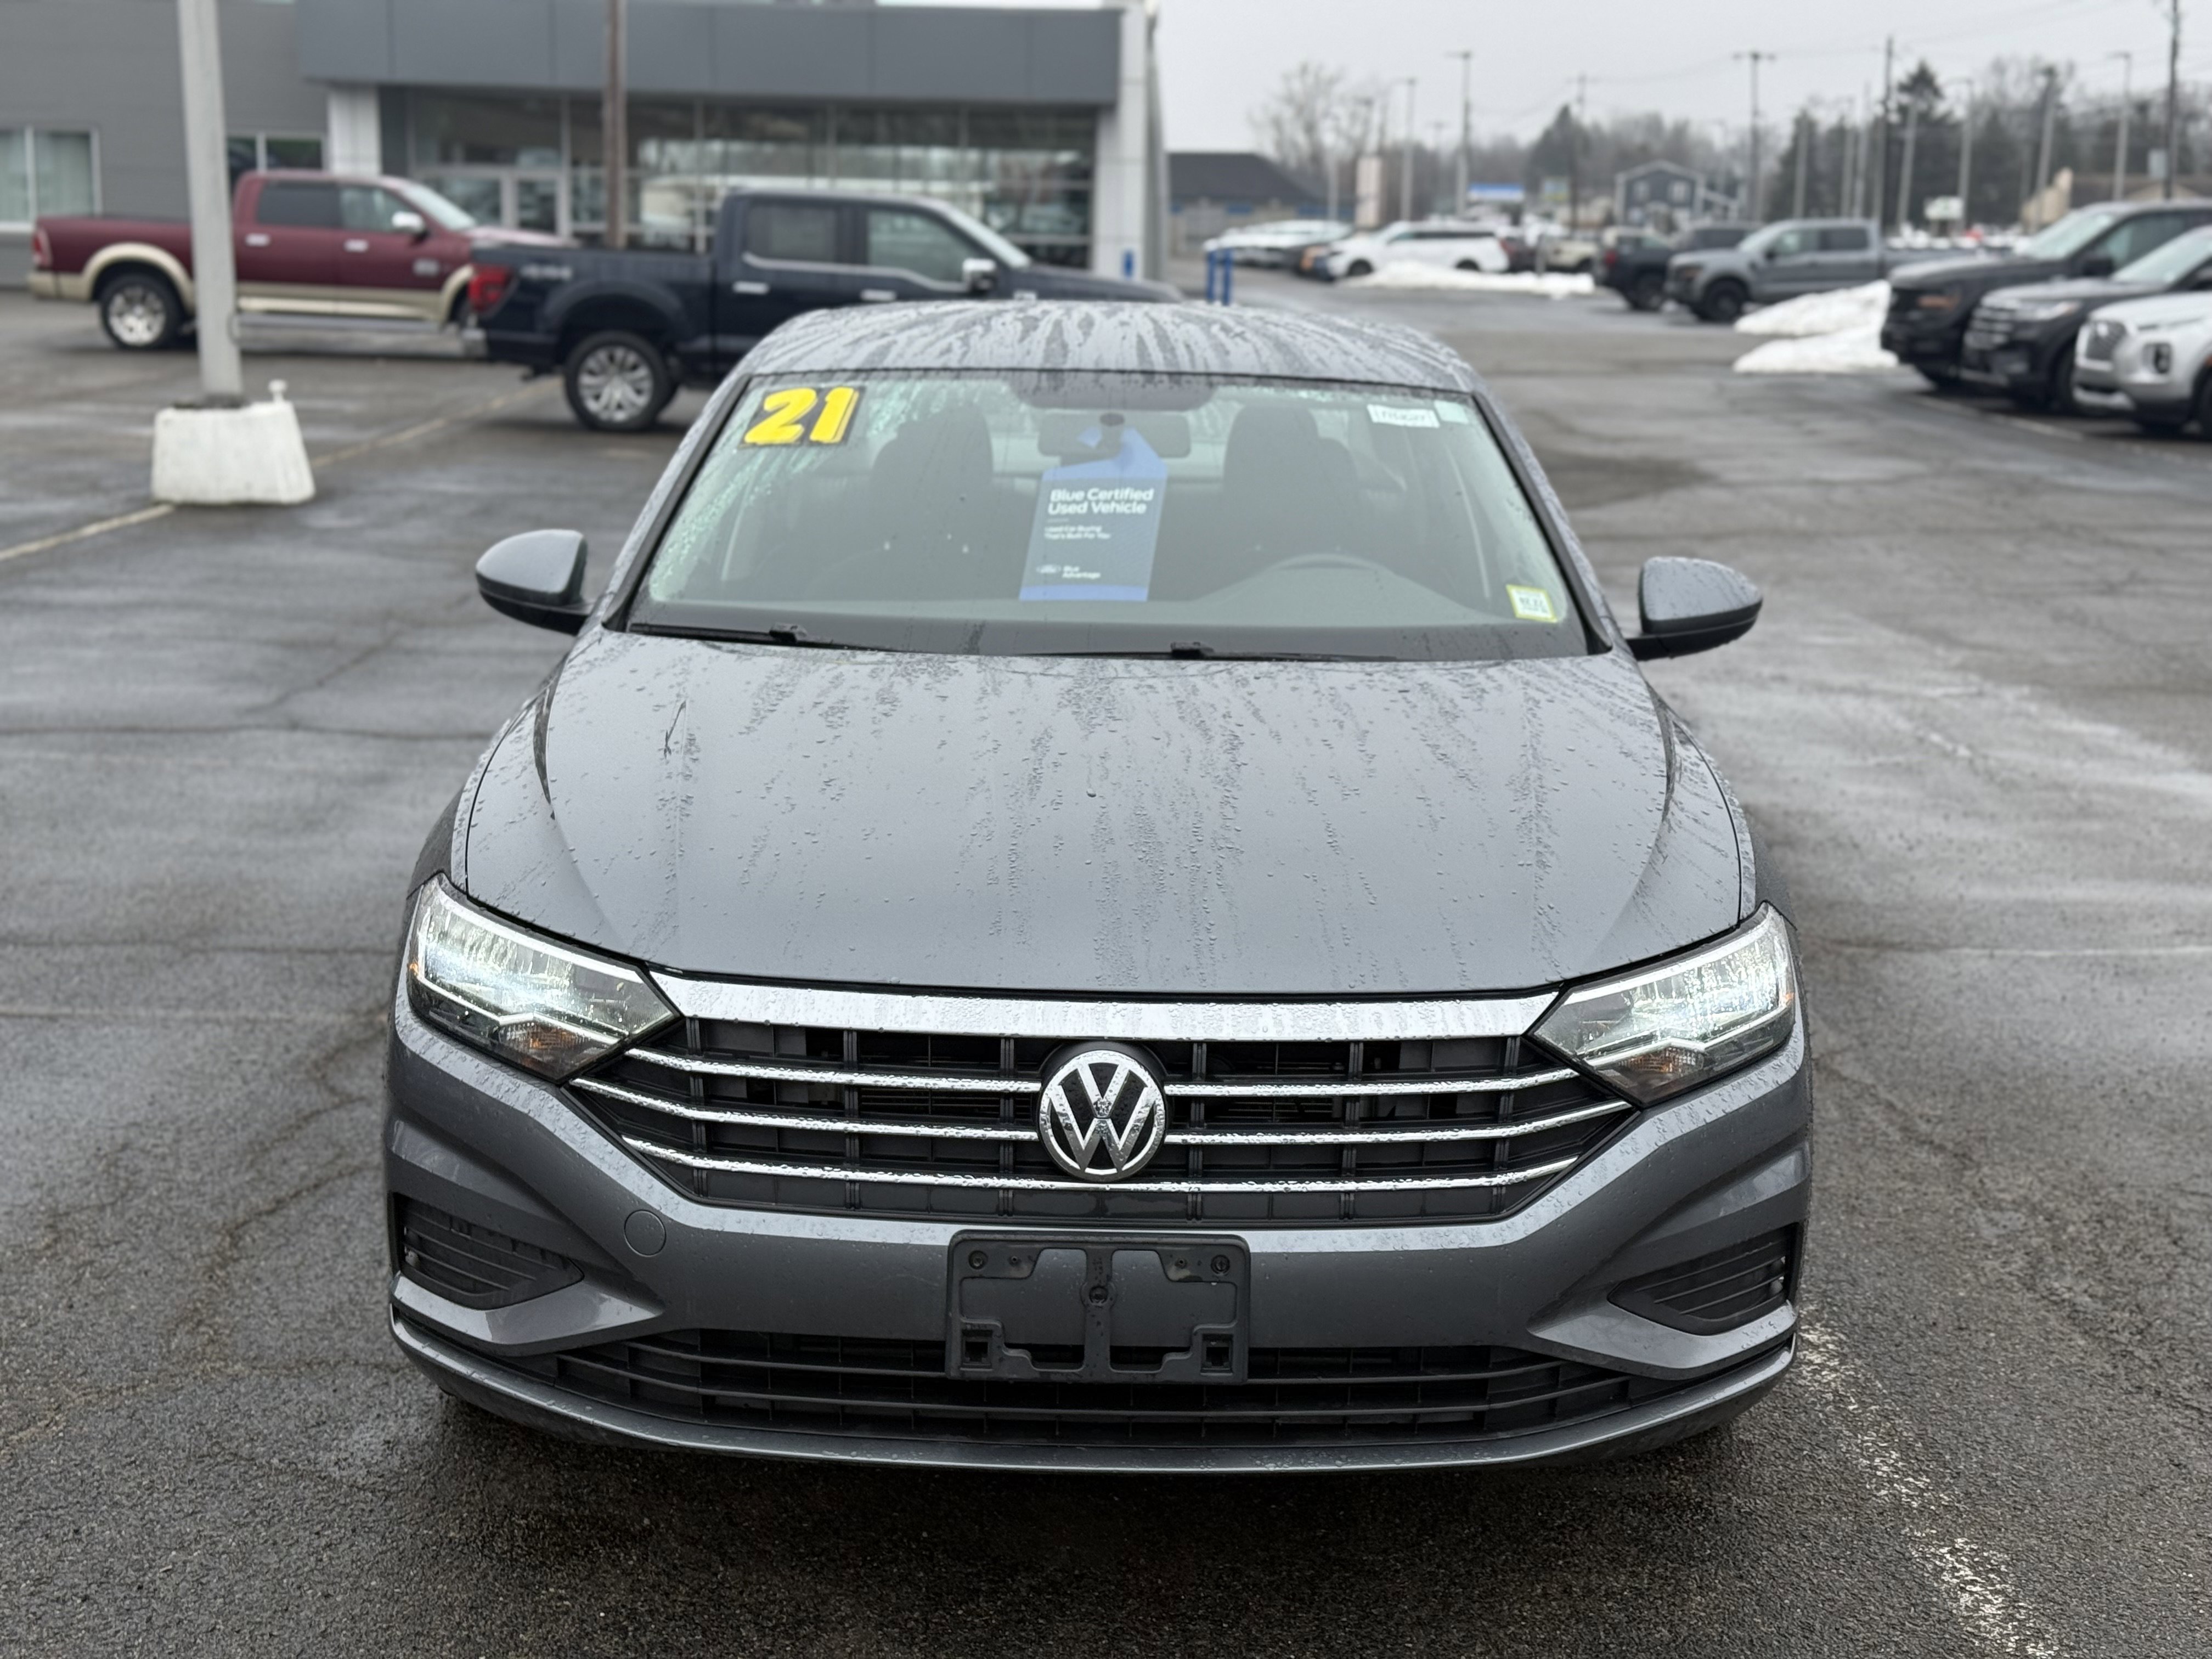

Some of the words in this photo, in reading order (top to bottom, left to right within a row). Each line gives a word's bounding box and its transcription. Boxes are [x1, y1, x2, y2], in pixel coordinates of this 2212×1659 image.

[744, 387, 859, 444] 21
[1050, 489, 1084, 501] Blue
[1087, 488, 1154, 501] Certified
[1048, 501, 1088, 515] Used
[1091, 500, 1147, 514] Vehicle
